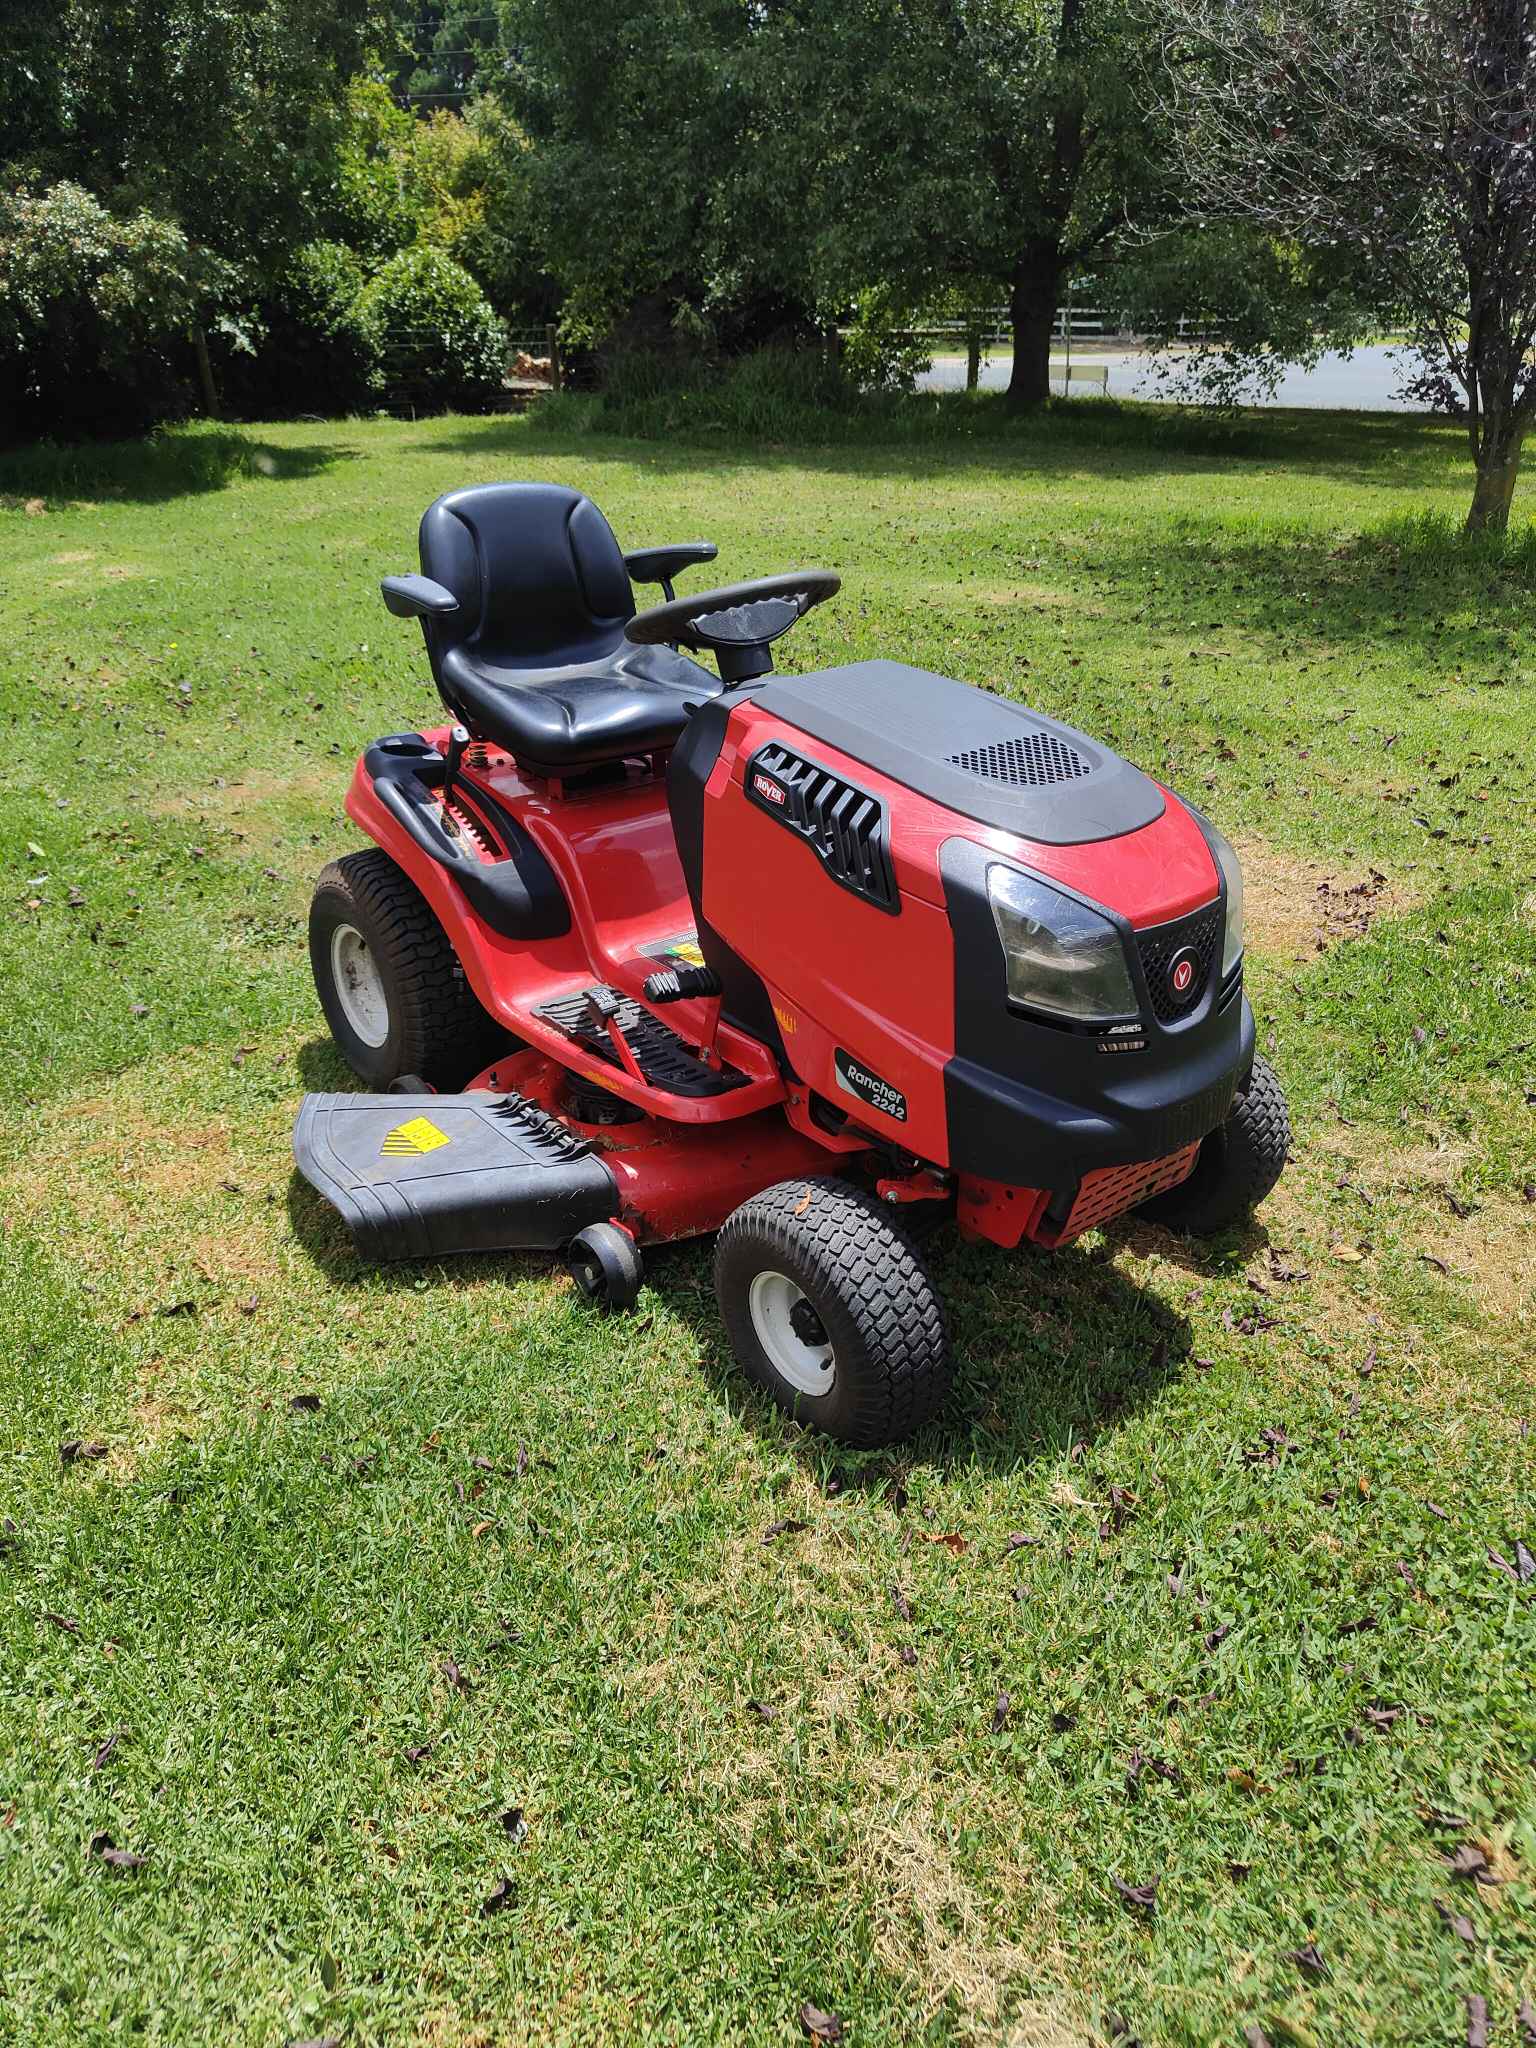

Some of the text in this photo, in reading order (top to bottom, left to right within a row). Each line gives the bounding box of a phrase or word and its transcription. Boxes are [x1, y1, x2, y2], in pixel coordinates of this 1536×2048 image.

[756, 776, 782, 802] ROVER
[847, 1064, 903, 1104] Rancher
[871, 1093, 905, 1120] 2242
